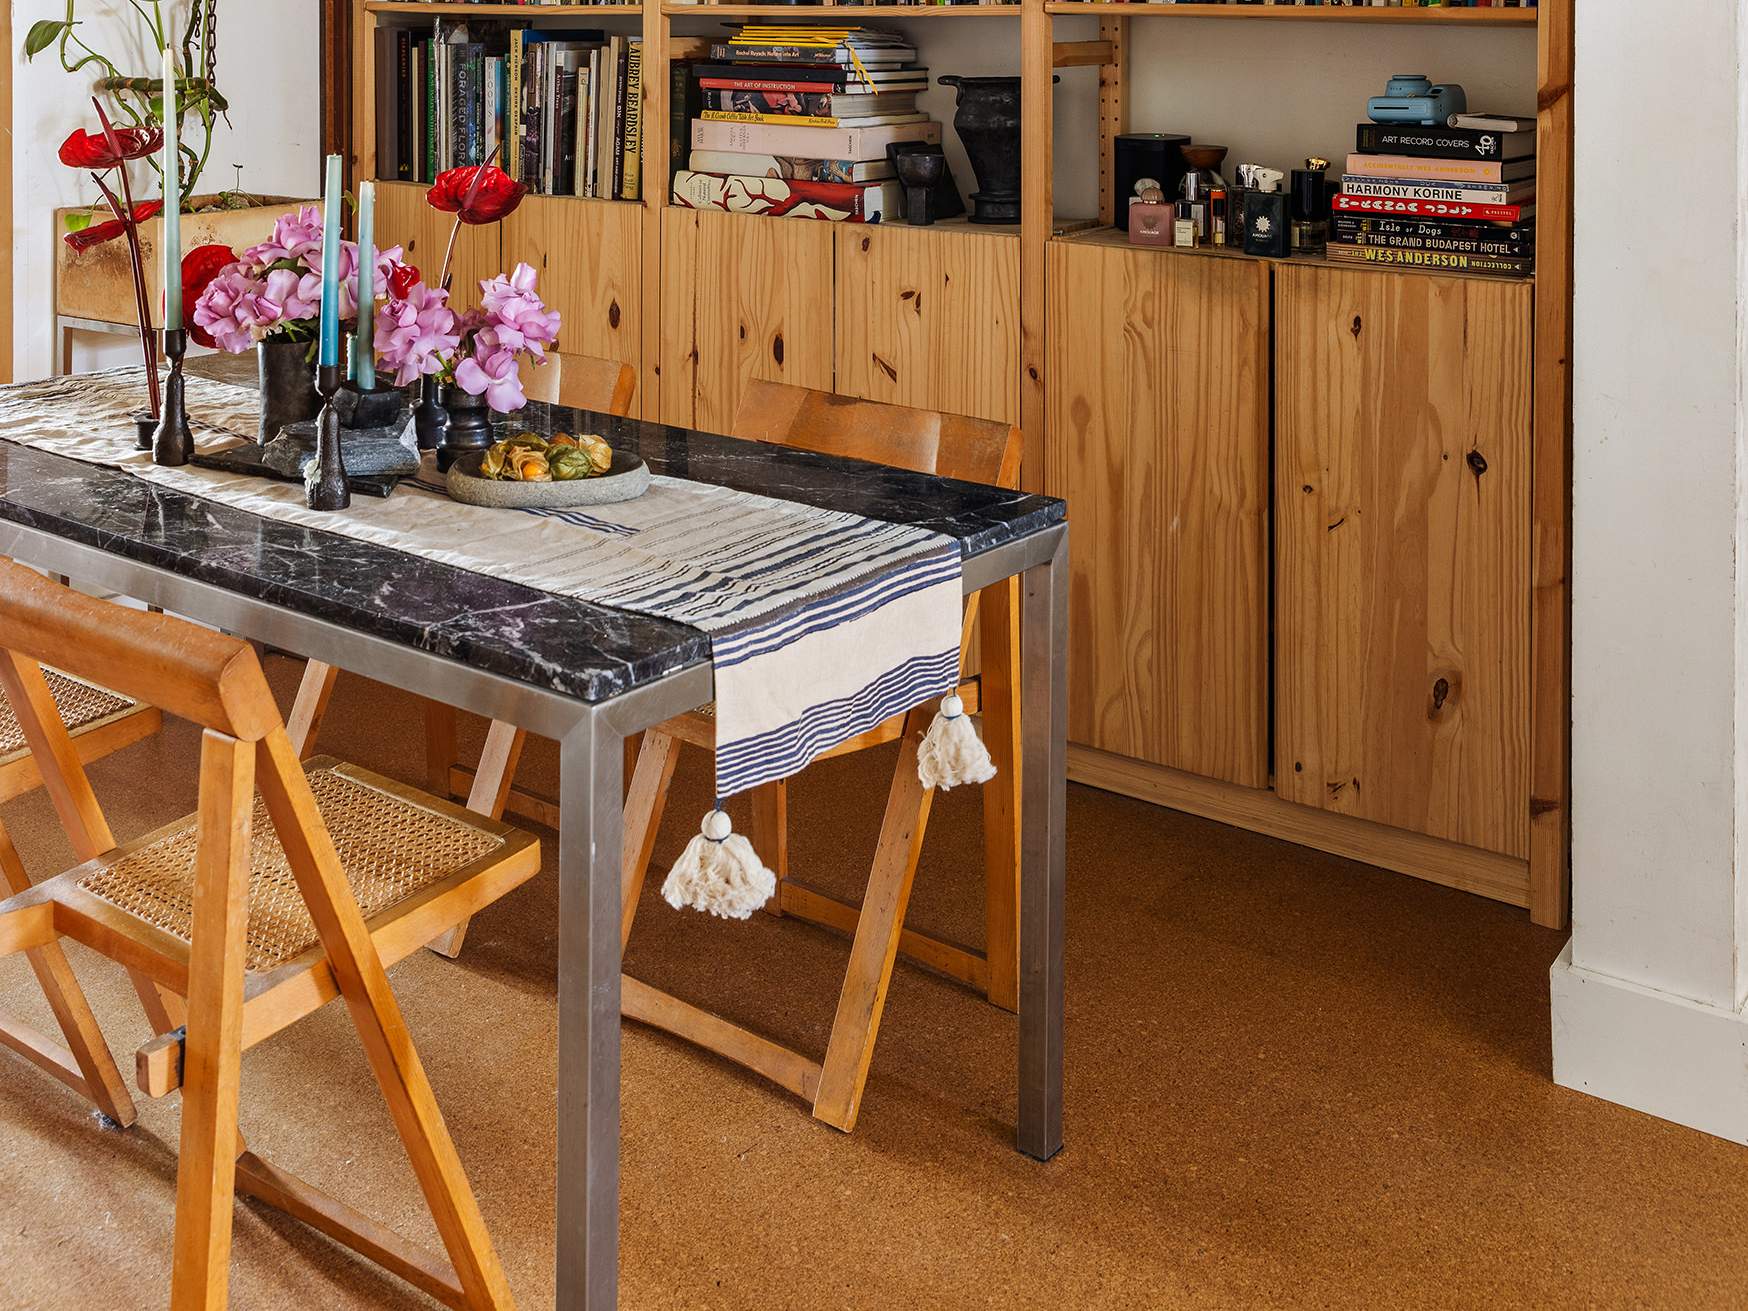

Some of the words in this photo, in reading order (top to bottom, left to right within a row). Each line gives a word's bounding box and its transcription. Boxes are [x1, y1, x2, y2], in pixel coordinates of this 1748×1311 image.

[628, 47, 641, 90] AUBREY
[458, 63, 467, 123] FORAGED
[624, 92, 639, 154] BEARDSLEY
[1382, 136, 1398, 144] ART
[1400, 136, 1434, 146] RECORD
[1435, 138, 1470, 148] COVERS
[1363, 162, 1414, 170] ACCIDENTALLY
[1434, 166, 1476, 174] ANDERSON
[1346, 183, 1409, 197] HARMONY
[1413, 187, 1462, 200] KORINE
[1339, 197, 1418, 212] MIRANDA
[1424, 204, 1472, 216] JULY
[1367, 234, 1386, 244] THE
[1389, 236, 1422, 247] GRAND
[1425, 239, 1478, 252] BUDAPEST
[1480, 242, 1511, 254] HOTEL
[1364, 248, 1394, 262] WES
[1396, 251, 1468, 268] ANDERSON
[1471, 260, 1512, 270] COLLECTION
